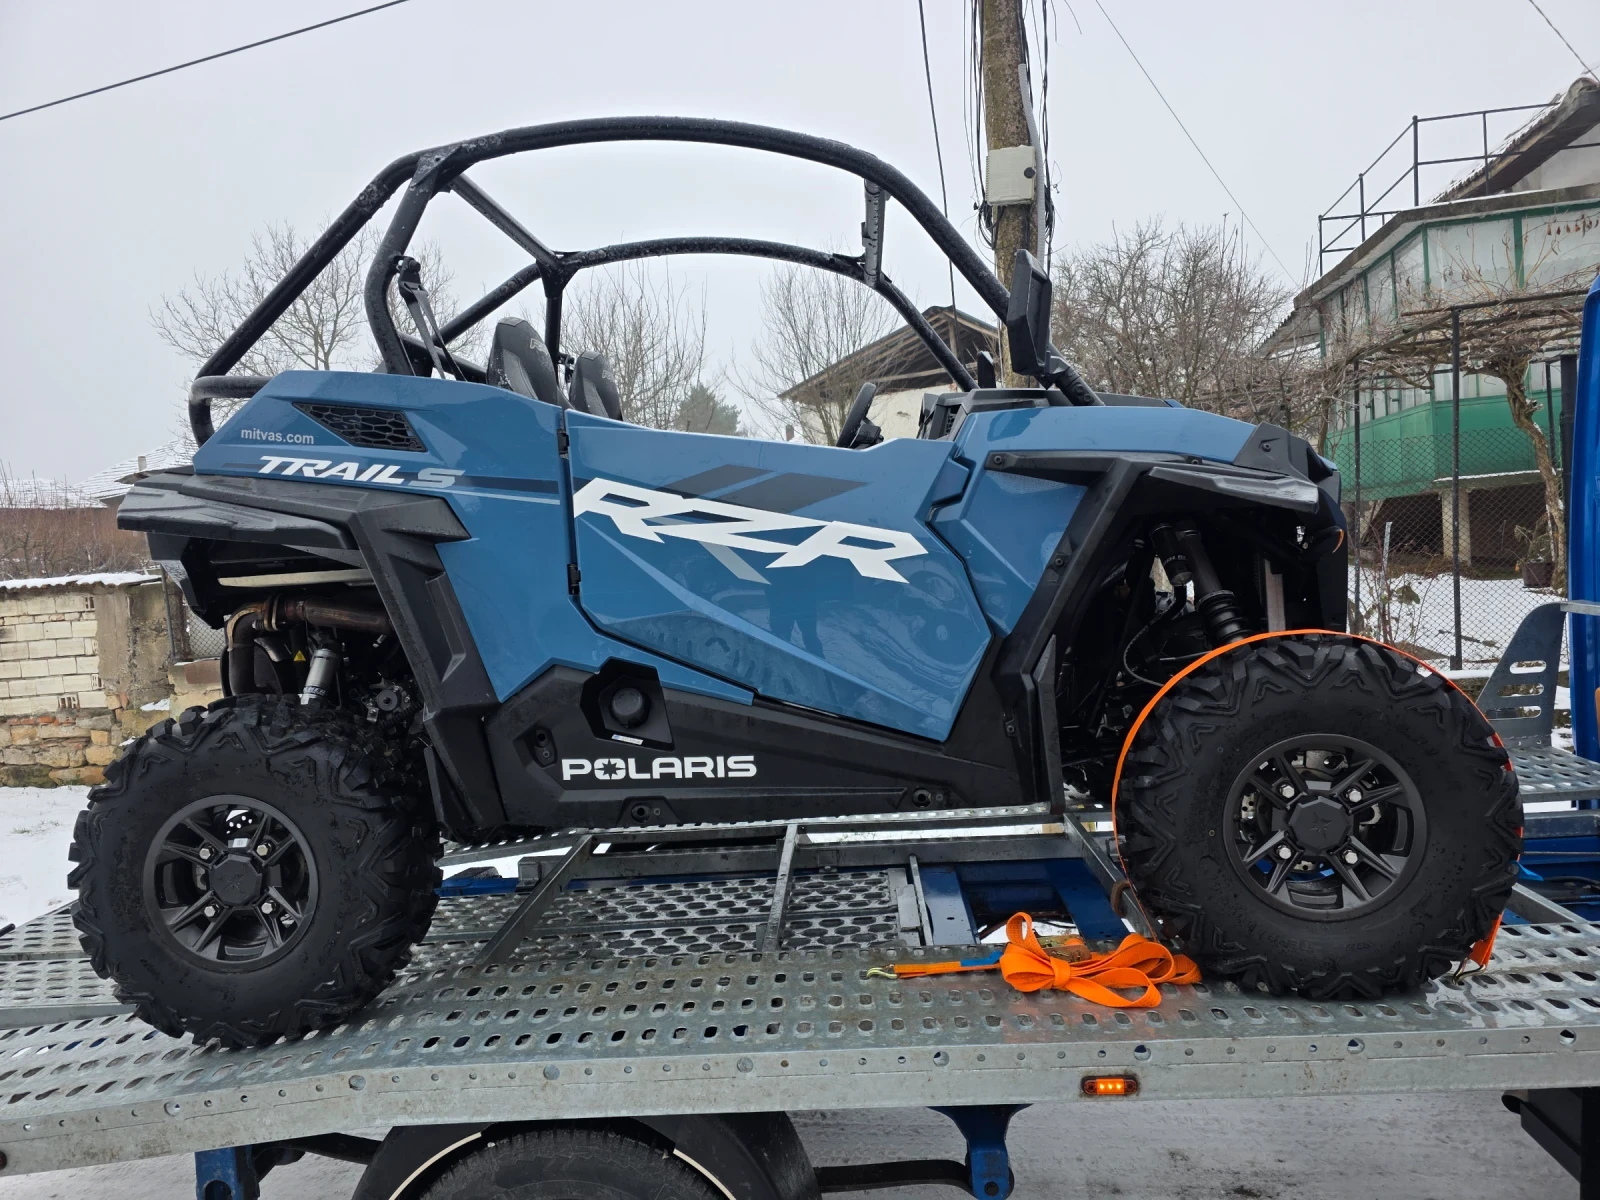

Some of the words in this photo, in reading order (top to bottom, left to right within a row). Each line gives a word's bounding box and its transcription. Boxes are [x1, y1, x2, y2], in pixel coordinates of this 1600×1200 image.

[240, 428, 315, 445] mitvas.com
[257, 455, 405, 484] TRAIL
[408, 467, 466, 489] S
[573, 477, 929, 584] RZR
[561, 755, 758, 781] POLARIS
